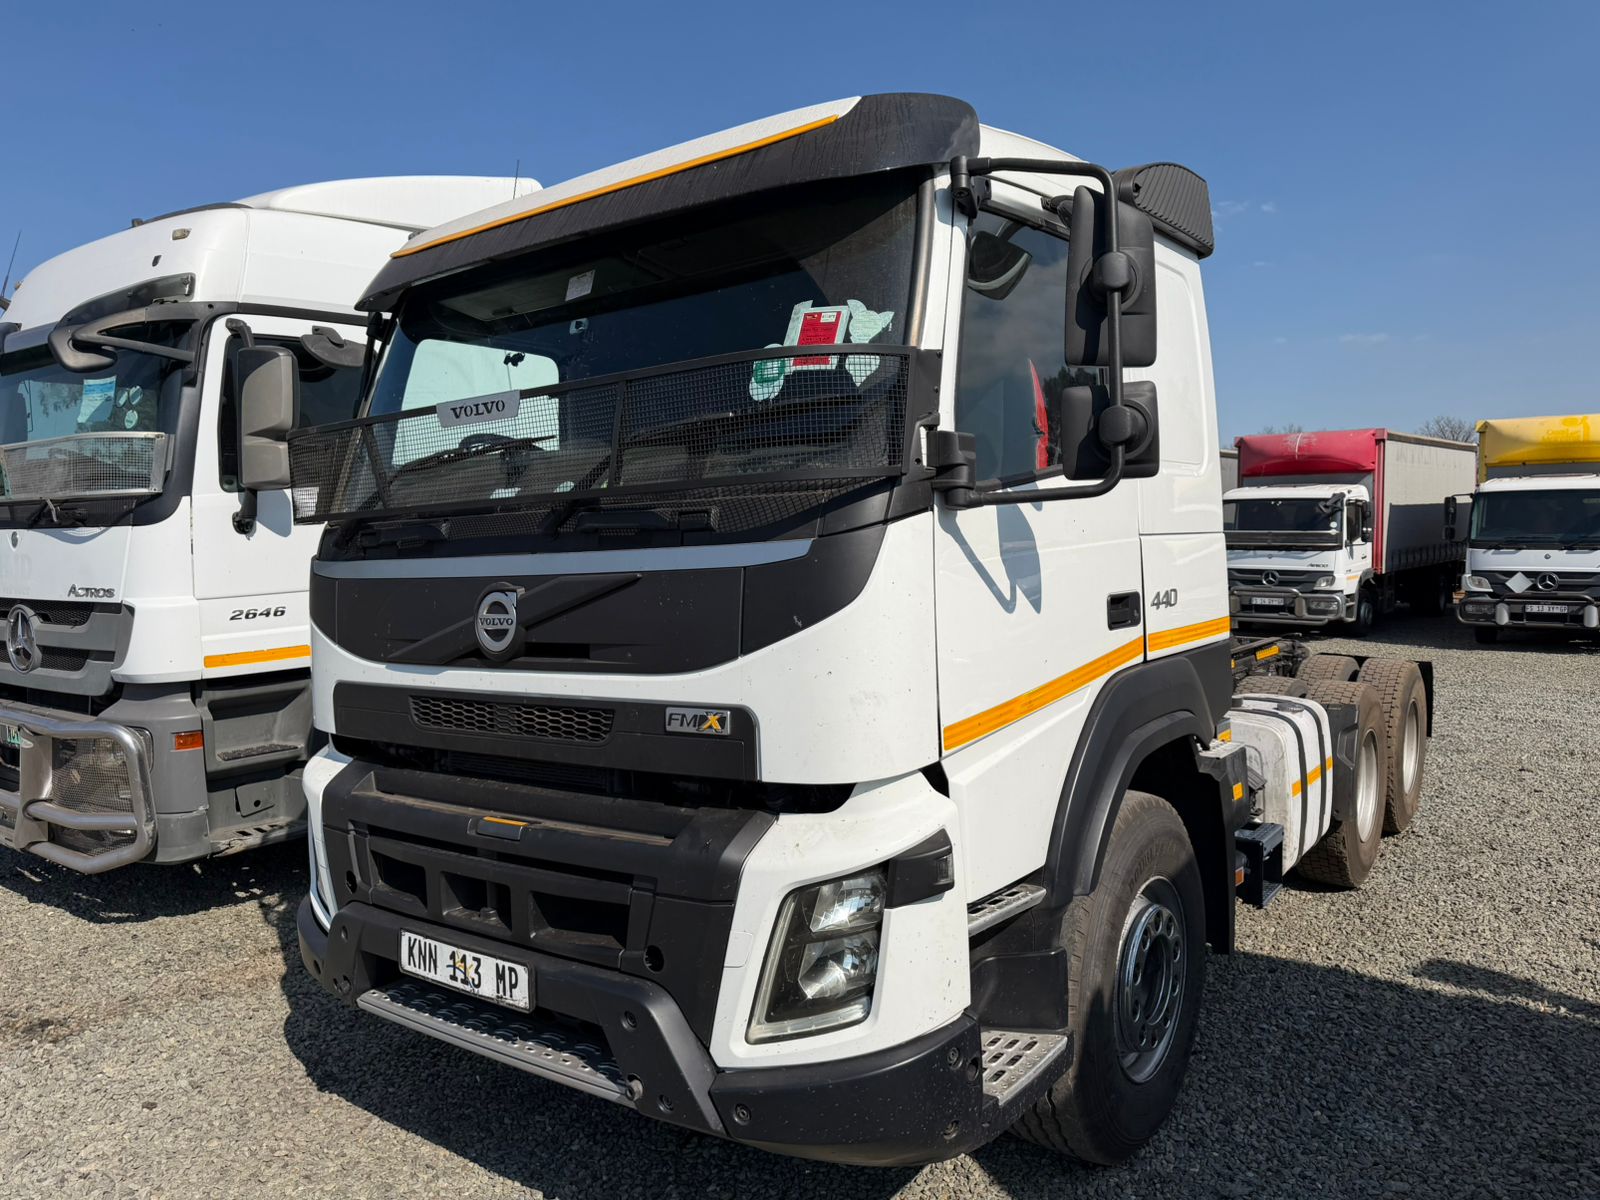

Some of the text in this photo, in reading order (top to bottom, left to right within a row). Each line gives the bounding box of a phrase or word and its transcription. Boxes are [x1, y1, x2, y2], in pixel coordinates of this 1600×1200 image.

[450, 400, 505, 419] VOLVO
[1150, 588, 1178, 610] 440
[229, 606, 287, 621] 2646
[479, 617, 514, 626] VOLVO
[667, 710, 727, 734] FMX
[408, 936, 519, 998] KNN 113 MP
